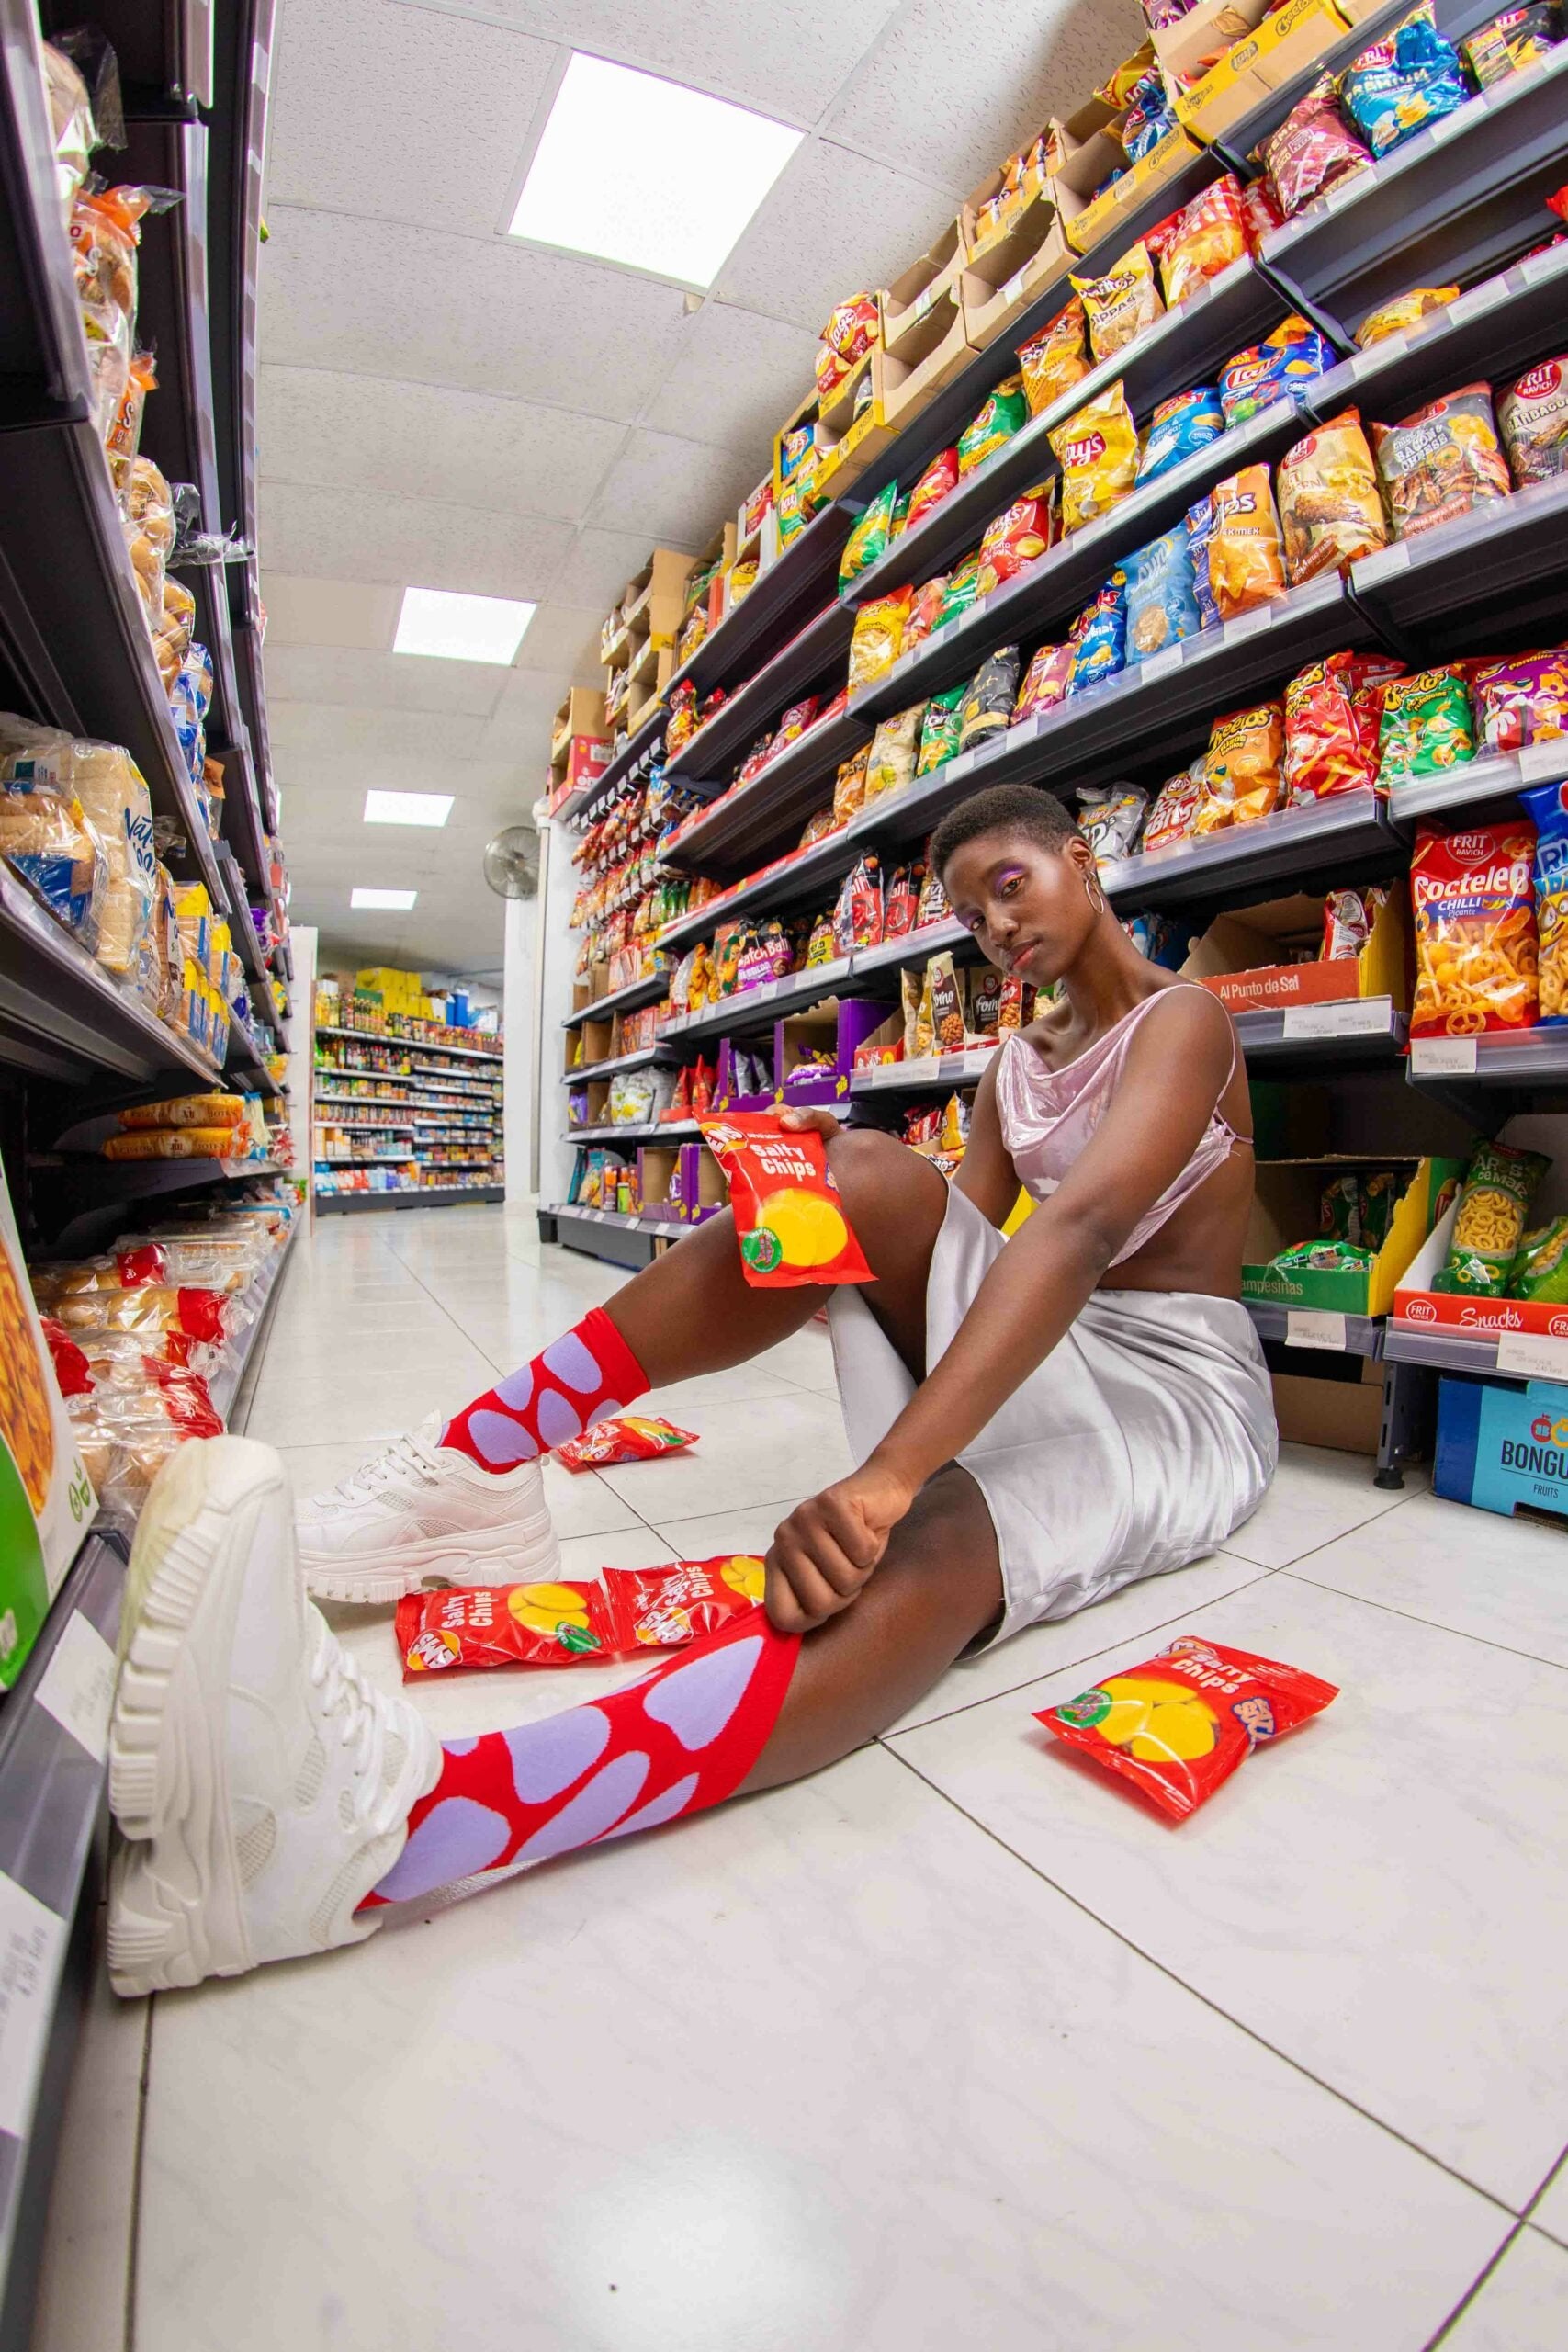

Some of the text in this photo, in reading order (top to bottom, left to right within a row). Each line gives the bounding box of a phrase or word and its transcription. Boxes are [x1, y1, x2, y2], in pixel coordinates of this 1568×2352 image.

[1276, 0, 1311, 36] Cheeto
[1523, 380, 1552, 395] RAVICH
[1507, 398, 1568, 430] BARBACO
[1064, 435, 1105, 468] ay's
[1453, 835, 1487, 849] FRIT
[1456, 848, 1483, 856] RAVICH
[1438, 897, 1481, 911] CHILLI
[1448, 908, 1476, 918] Picante
[1220, 986, 1229, 1000] Al
[1231, 982, 1263, 999] Punto
[1264, 978, 1280, 994] de
[750, 1143, 806, 1160] Salty
[761, 1157, 817, 1182] Chips
[1411, 1305, 1432, 1316] FRIT
[1459, 1306, 1524, 1329] Snacks
[1533, 1484, 1559, 1499] FRUITS
[686, 1565, 715, 1599] Chips
[442, 1594, 472, 1629] Salty
[469, 1591, 501, 1626] Chips
[1171, 1659, 1241, 1694] Chips
